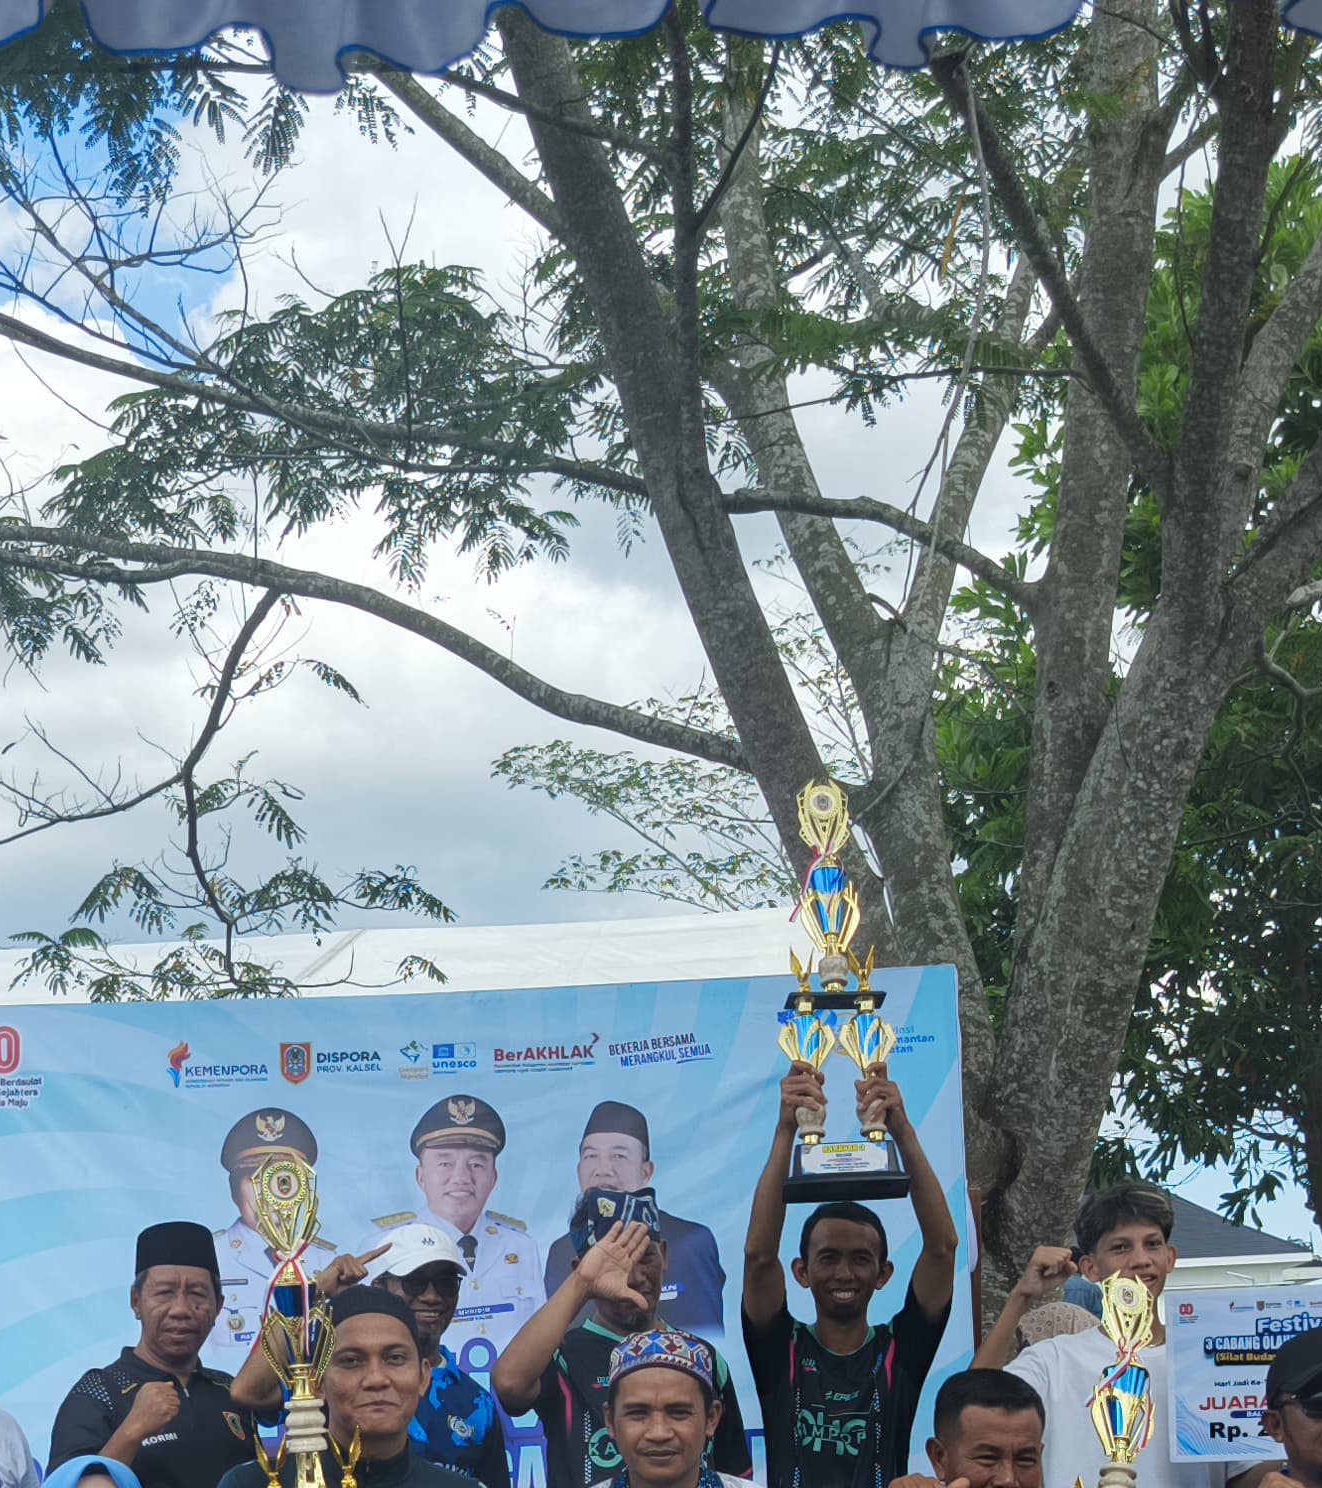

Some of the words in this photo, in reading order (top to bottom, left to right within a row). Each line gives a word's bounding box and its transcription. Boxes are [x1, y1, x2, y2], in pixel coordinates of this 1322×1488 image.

[609, 1037, 650, 1056] BEKERJA
[651, 1032, 696, 1050] BERSAMA
[316, 1051, 381, 1063] DISPORA
[493, 1045, 595, 1062] BerAKHLAK
[620, 1051, 677, 1067] MERANGKUL
[678, 1044, 712, 1059] SEMUA
[184, 1064, 269, 1077] KEMENPORA
[316, 1064, 344, 1073] PROV.
[346, 1063, 382, 1073] KALSEL
[432, 1060, 477, 1069] unesco
[1205, 1337, 1213, 1350] 3
[1215, 1336, 1260, 1350] CABANG
[1199, 1395, 1269, 1410] JUARA
[1209, 1422, 1249, 1442] Rp.
